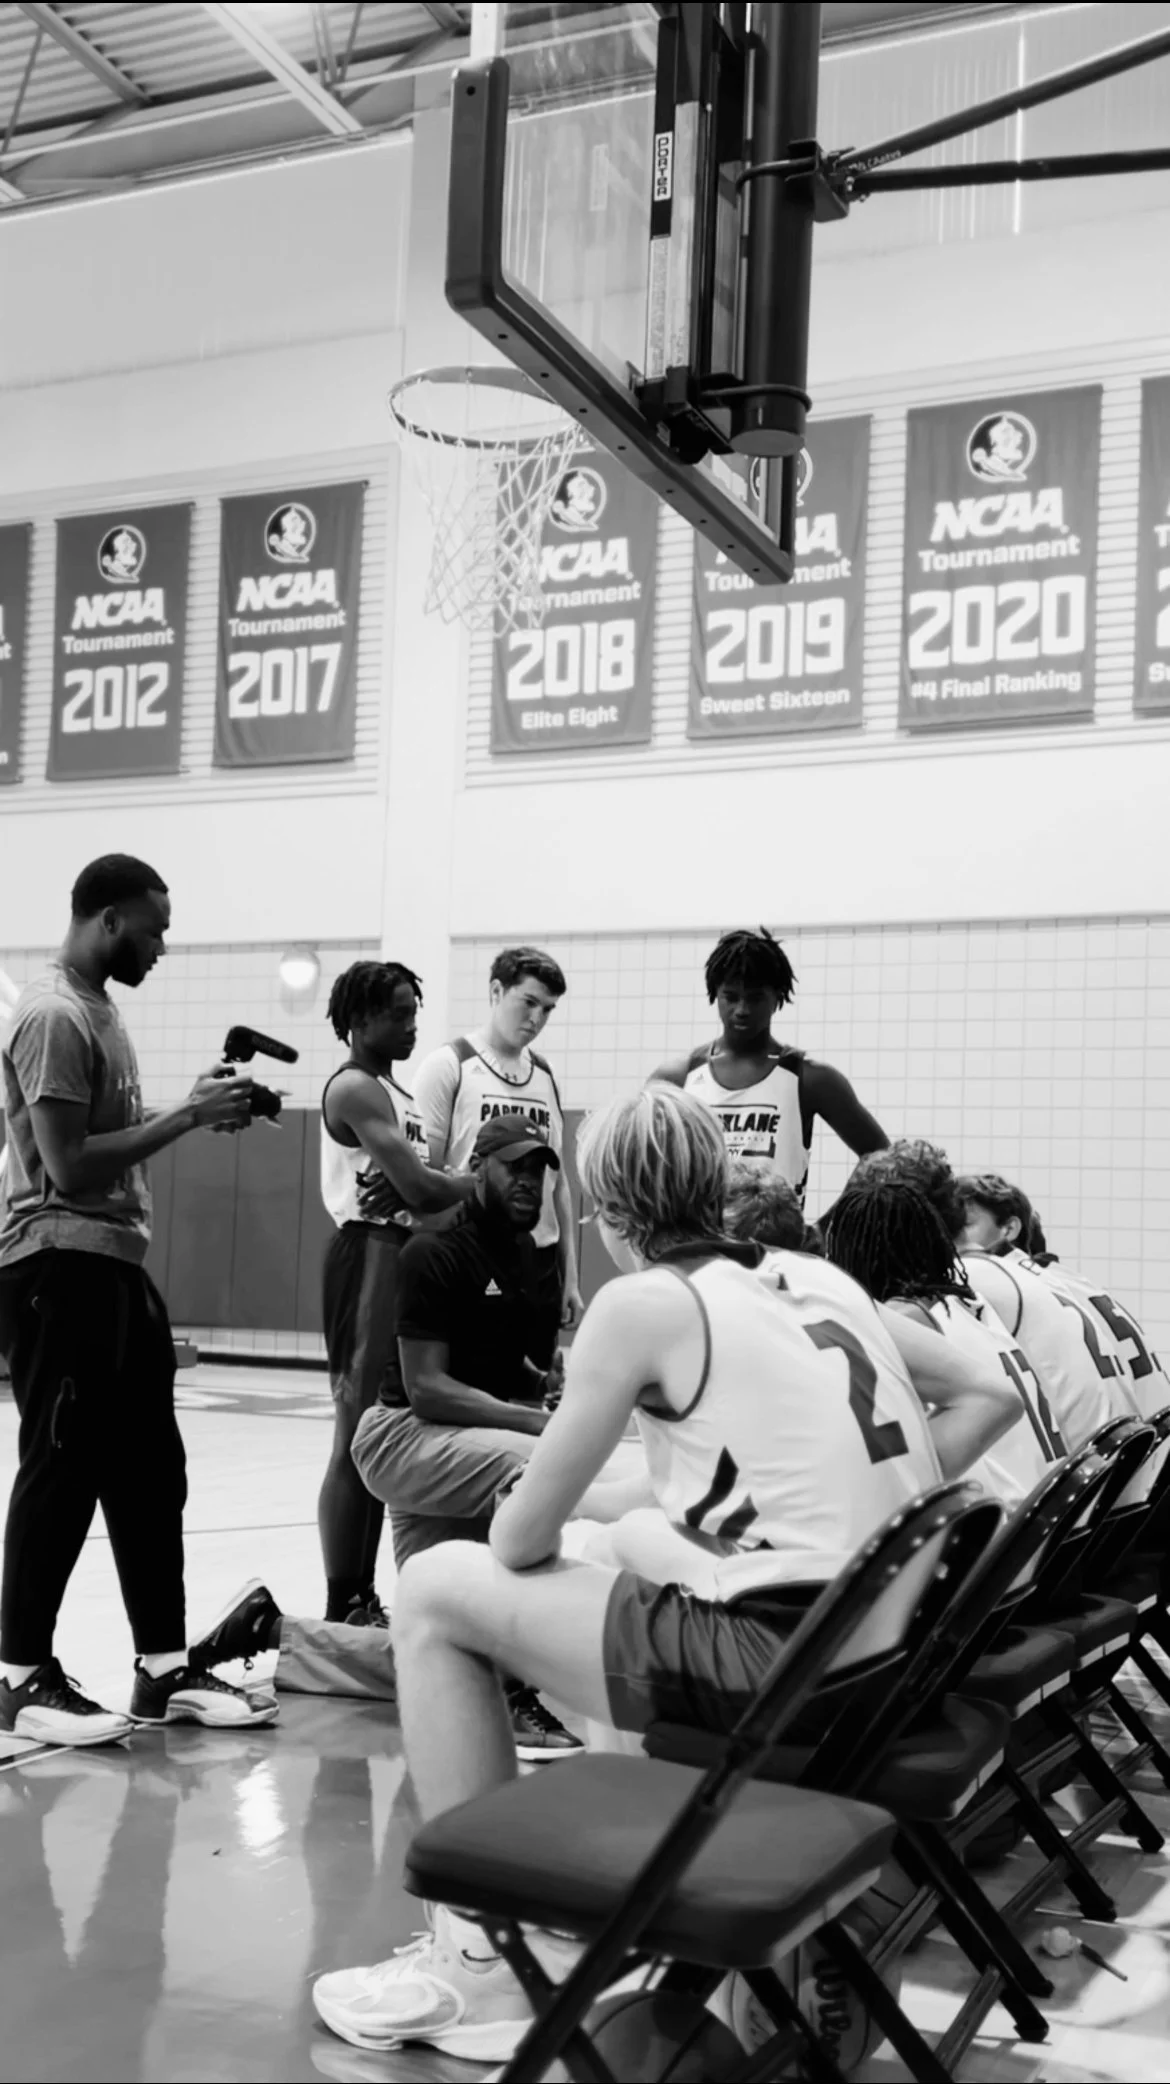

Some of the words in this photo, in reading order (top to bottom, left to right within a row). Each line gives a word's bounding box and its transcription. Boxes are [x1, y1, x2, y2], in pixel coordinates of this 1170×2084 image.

[657, 136, 669, 196] PORTER
[930, 487, 1063, 542] NCAA
[704, 556, 852, 592] Toument
[918, 534, 1080, 572] Tournament
[71, 587, 164, 630] NCAA
[236, 568, 336, 612] NCAA
[62, 627, 174, 654] Tournament
[228, 608, 346, 637] Tournament
[705, 598, 845, 683] 2019
[908, 574, 1086, 669] 2020
[228, 642, 343, 719] 2017
[507, 618, 636, 700] 2018
[61, 662, 170, 734] 2012
[700, 695, 764, 716] Sweet
[769, 688, 851, 711] Sixteen
[941, 674, 991, 699] Final
[995, 669, 1082, 695] Ranking
[521, 710, 564, 730] Elite
[568, 704, 618, 728] Eight
[801, 1319, 909, 1465] 2
[999, 1348, 1068, 1462] 12
